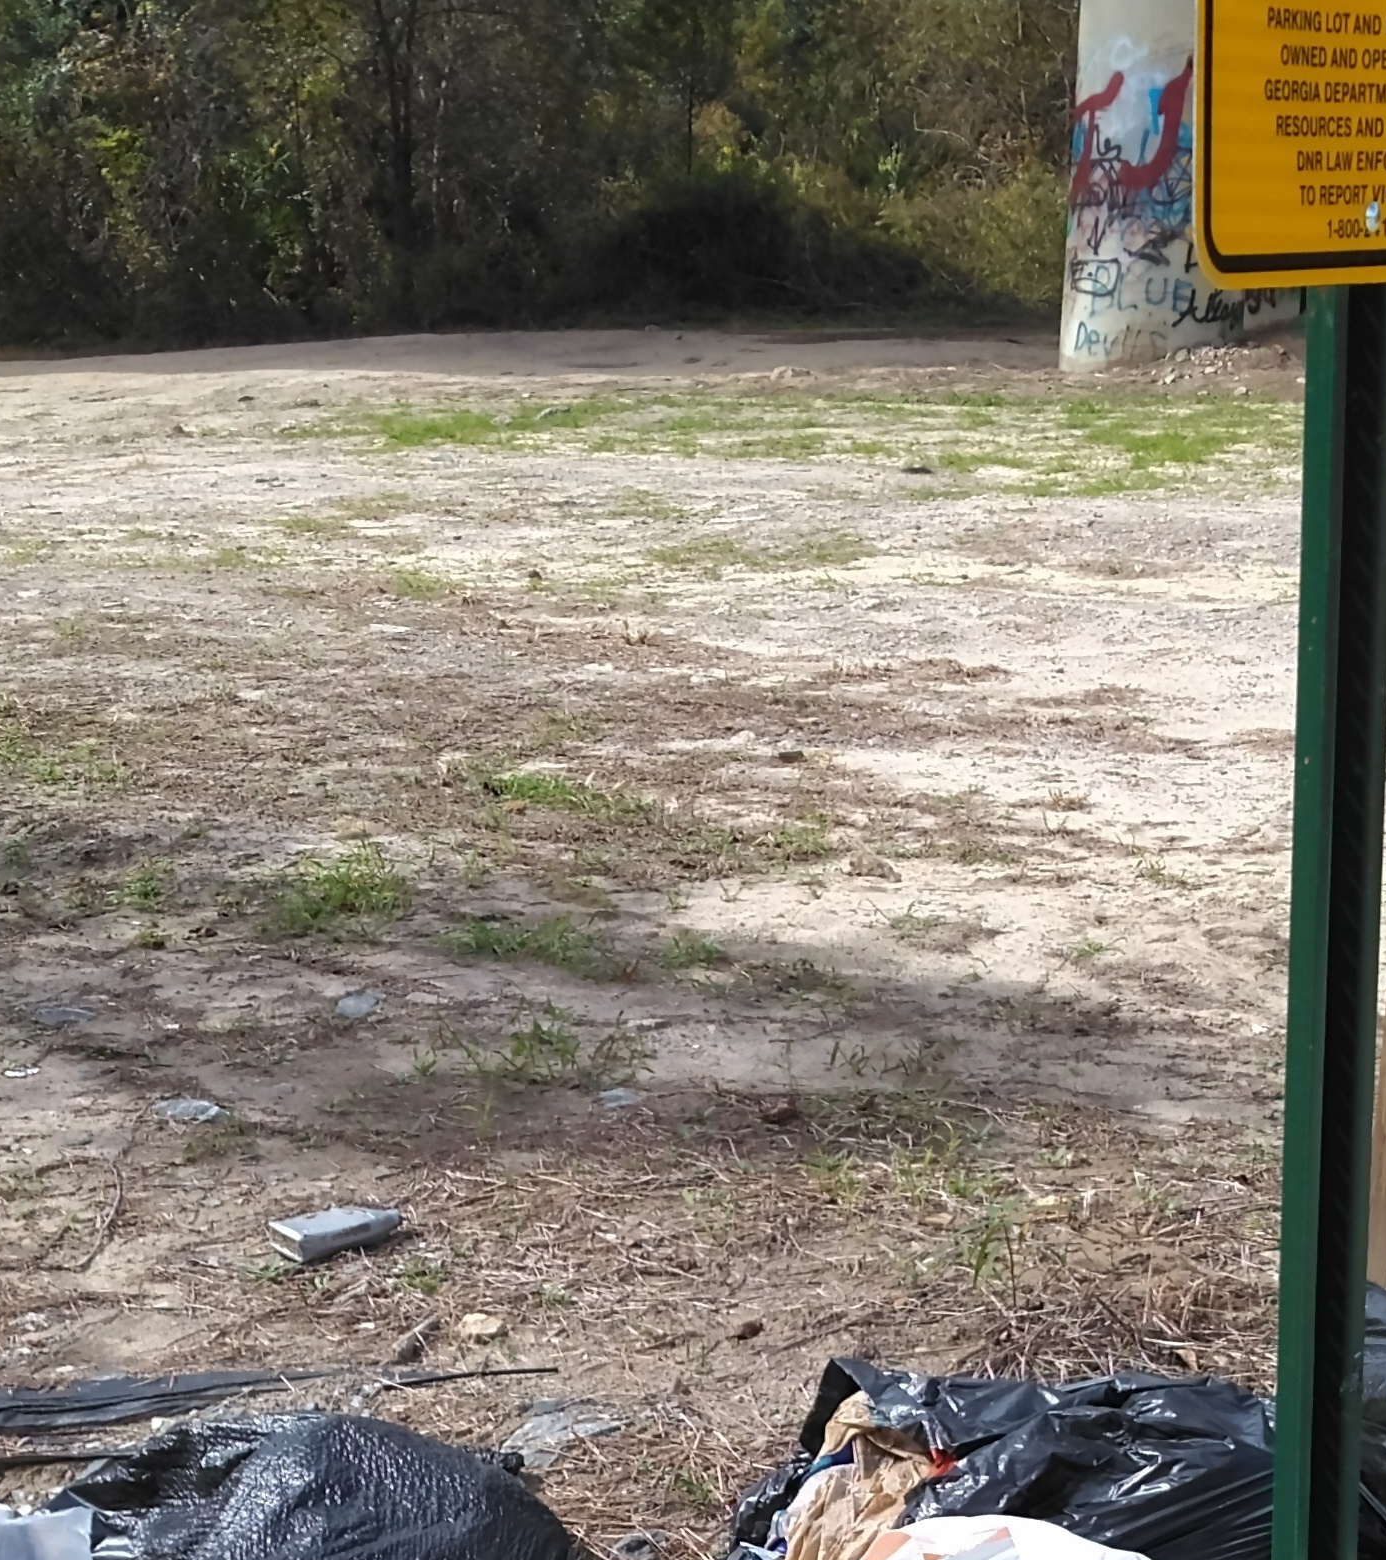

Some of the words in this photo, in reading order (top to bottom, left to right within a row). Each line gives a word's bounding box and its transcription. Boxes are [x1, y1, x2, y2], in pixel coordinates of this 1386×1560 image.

[1267, 7, 1322, 32] PARKING
[1325, 13, 1350, 33] LOT
[1353, 14, 1382, 36] AND
[1280, 44, 1327, 67] OWNED
[1330, 47, 1358, 69] AND
[1264, 79, 1320, 102] GEORGIA
[1276, 115, 1352, 137] RESOURCES
[1356, 117, 1384, 137] AND
[1297, 150, 1323, 171] DNR
[1326, 151, 1352, 171] LAW
[1299, 185, 1315, 205] TO
[1320, 184, 1368, 205] REPORT
